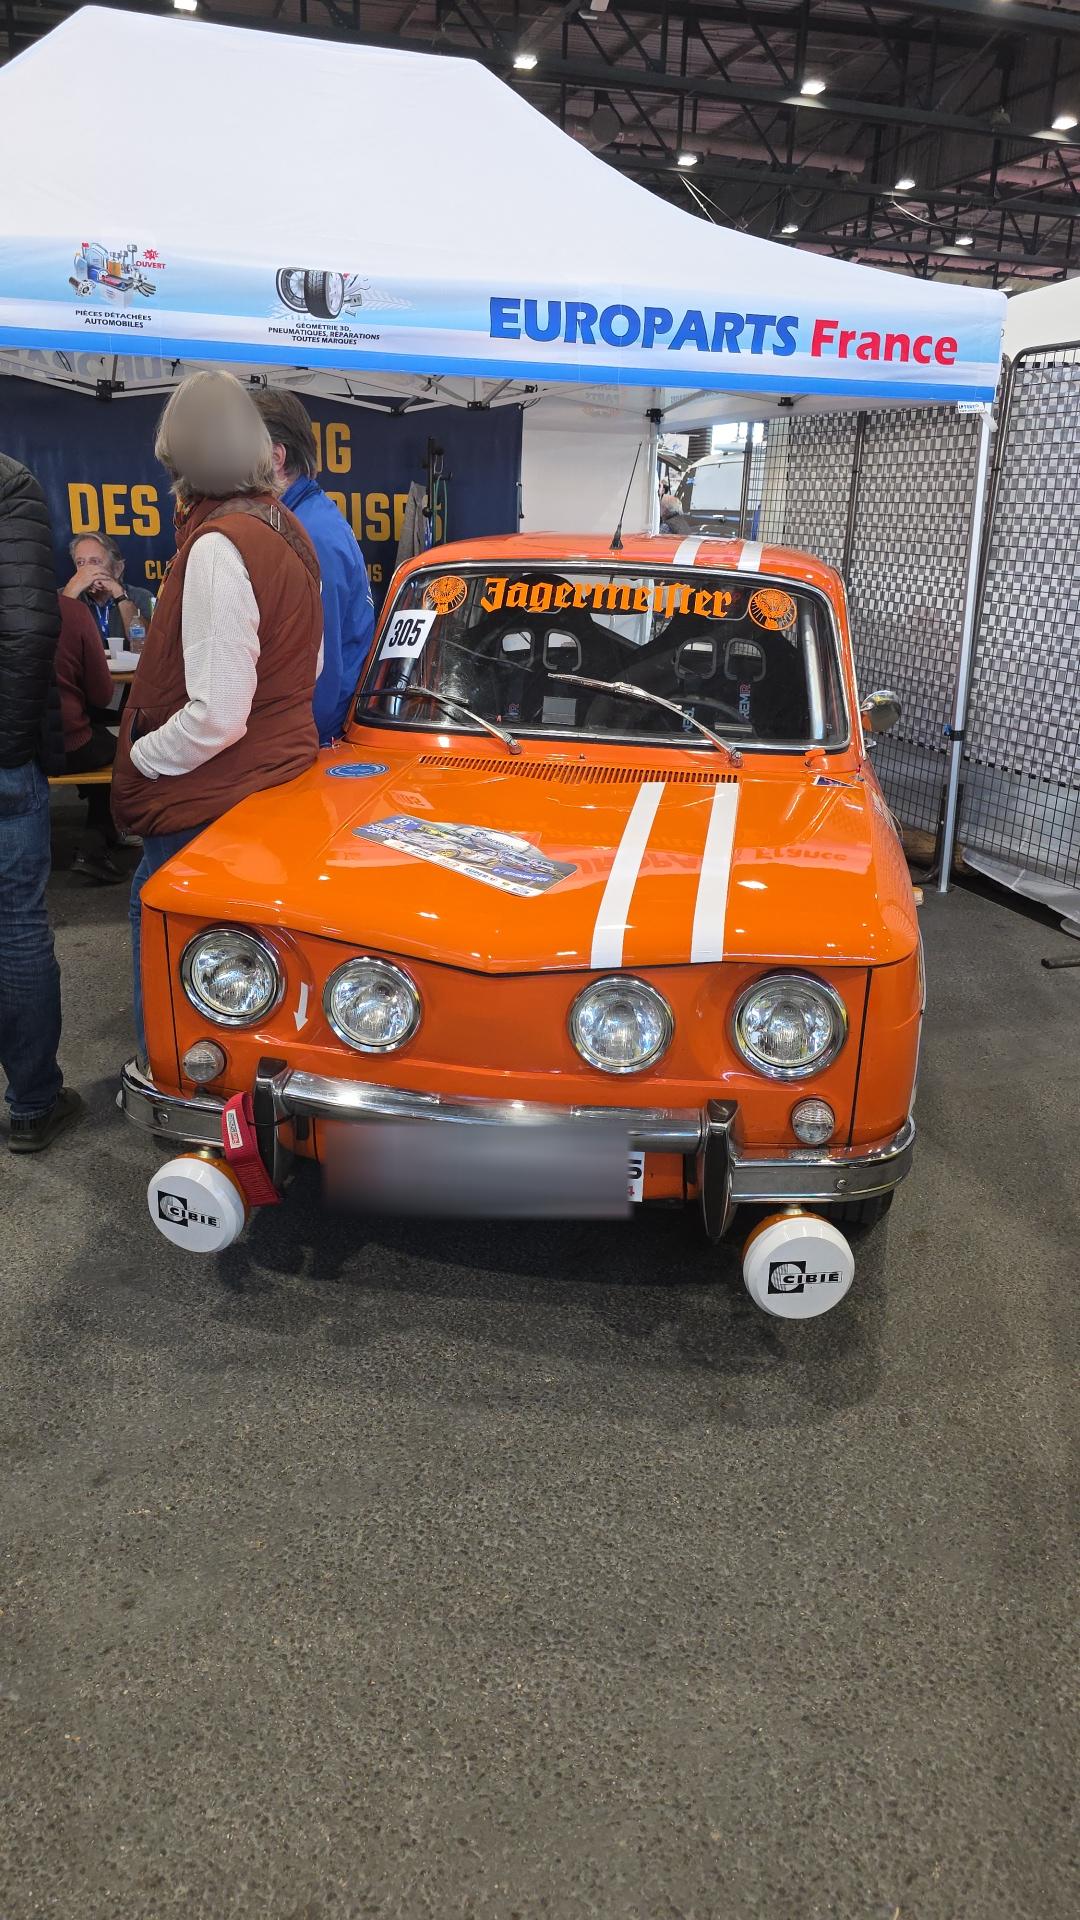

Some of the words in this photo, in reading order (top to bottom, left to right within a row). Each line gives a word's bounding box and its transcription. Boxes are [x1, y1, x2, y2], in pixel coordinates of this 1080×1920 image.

[135, 260, 166, 269] OUVERT
[84, 318, 144, 328] AUTOMOBILES
[489, 297, 799, 356] EUROPARTS
[810, 319, 958, 366] France
[292, 335, 320, 343] TOUTES
[321, 337, 357, 345] MARQUES
[68, 483, 161, 537] DES
[388, 618, 426, 648] 305
